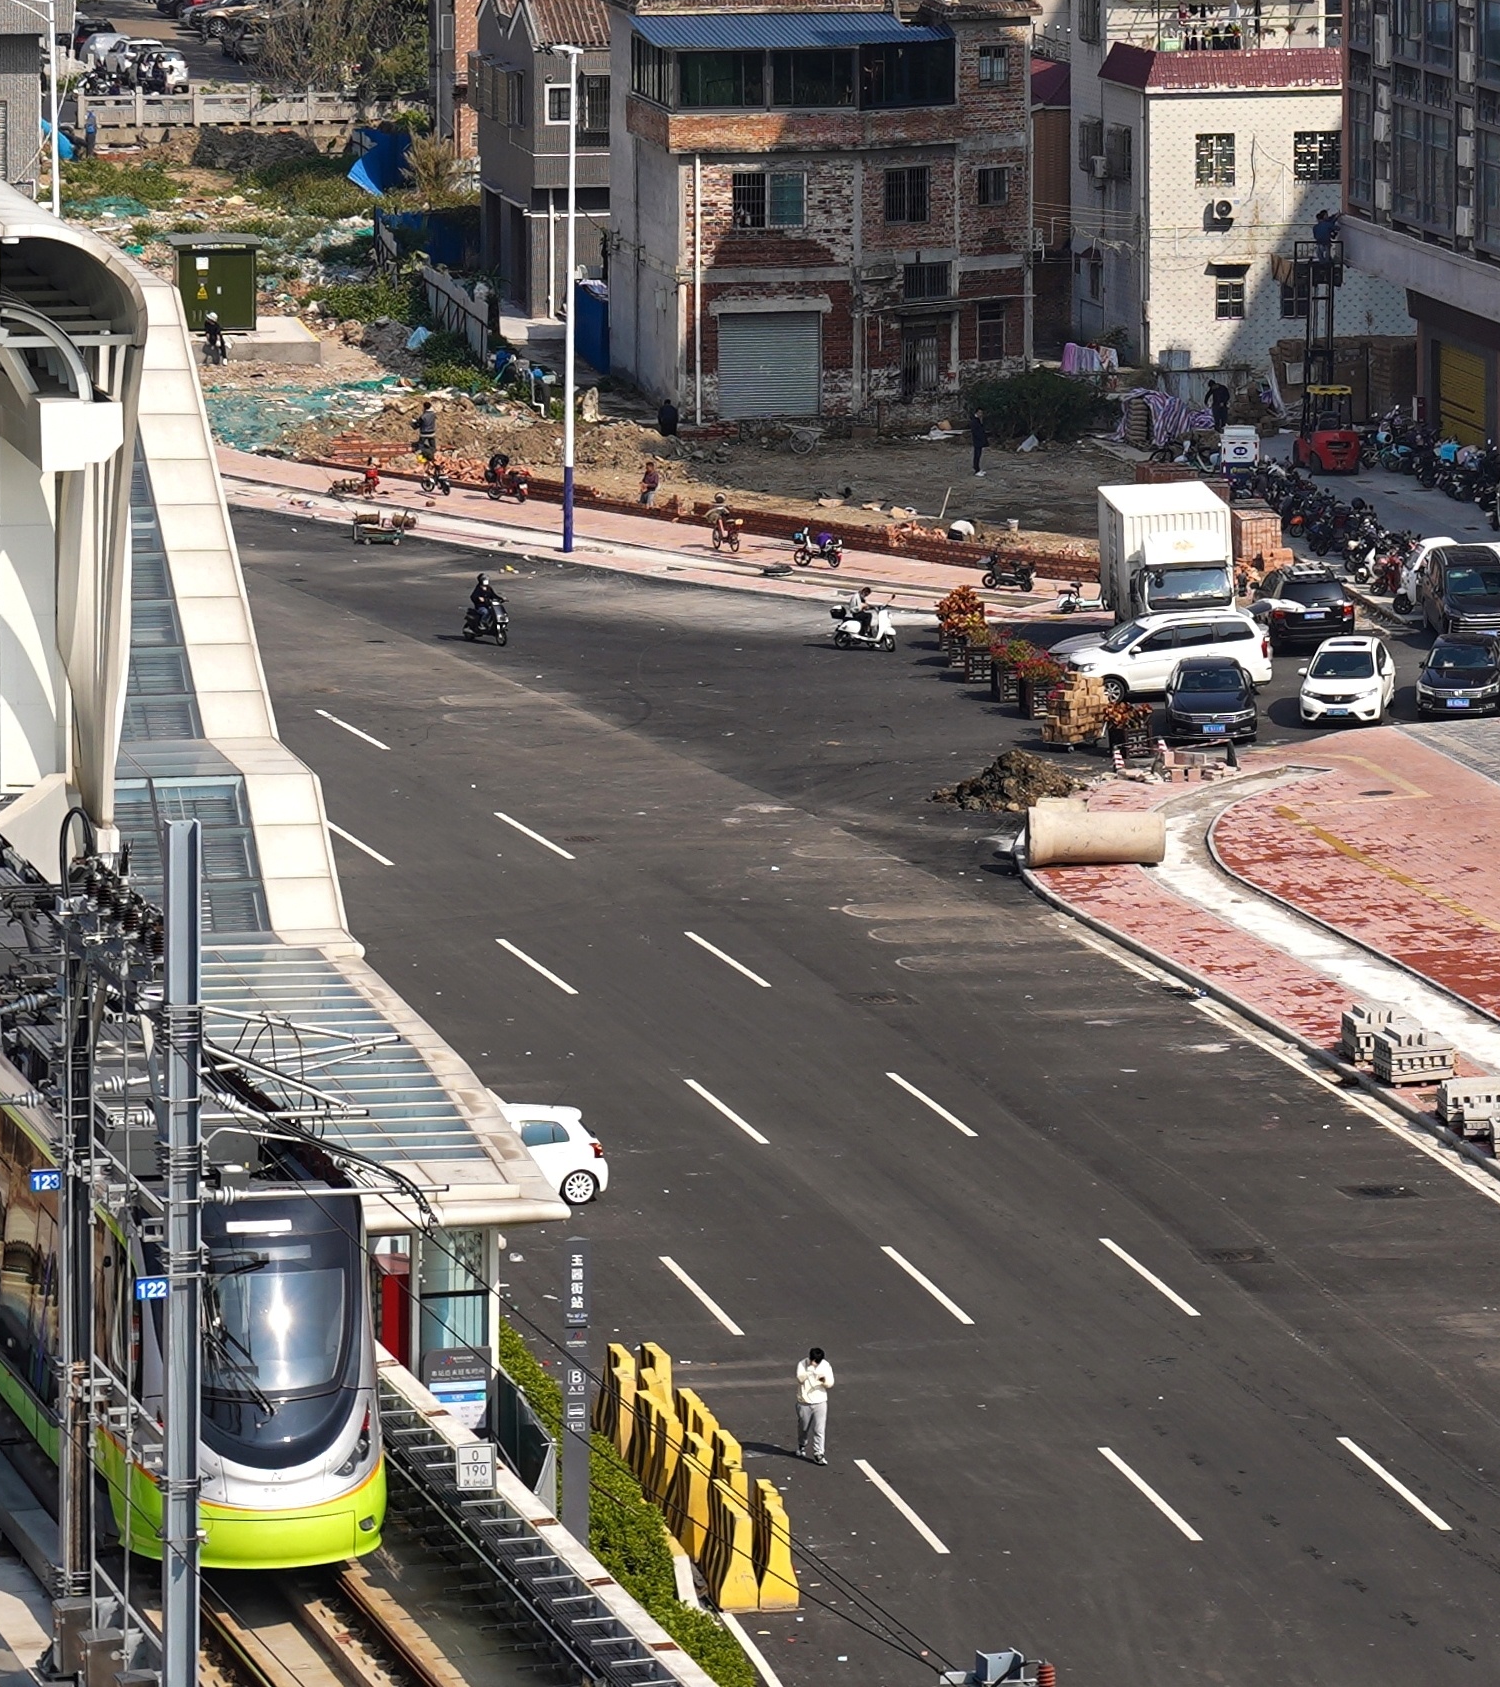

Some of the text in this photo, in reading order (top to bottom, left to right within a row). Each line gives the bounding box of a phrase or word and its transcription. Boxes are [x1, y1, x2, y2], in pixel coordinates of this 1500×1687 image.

[33, 1173, 60, 1190] 123
[137, 1282, 167, 1297] 122
[572, 1371, 582, 1383] B
[472, 1450, 479, 1461] 0
[466, 1464, 487, 1476] 190
